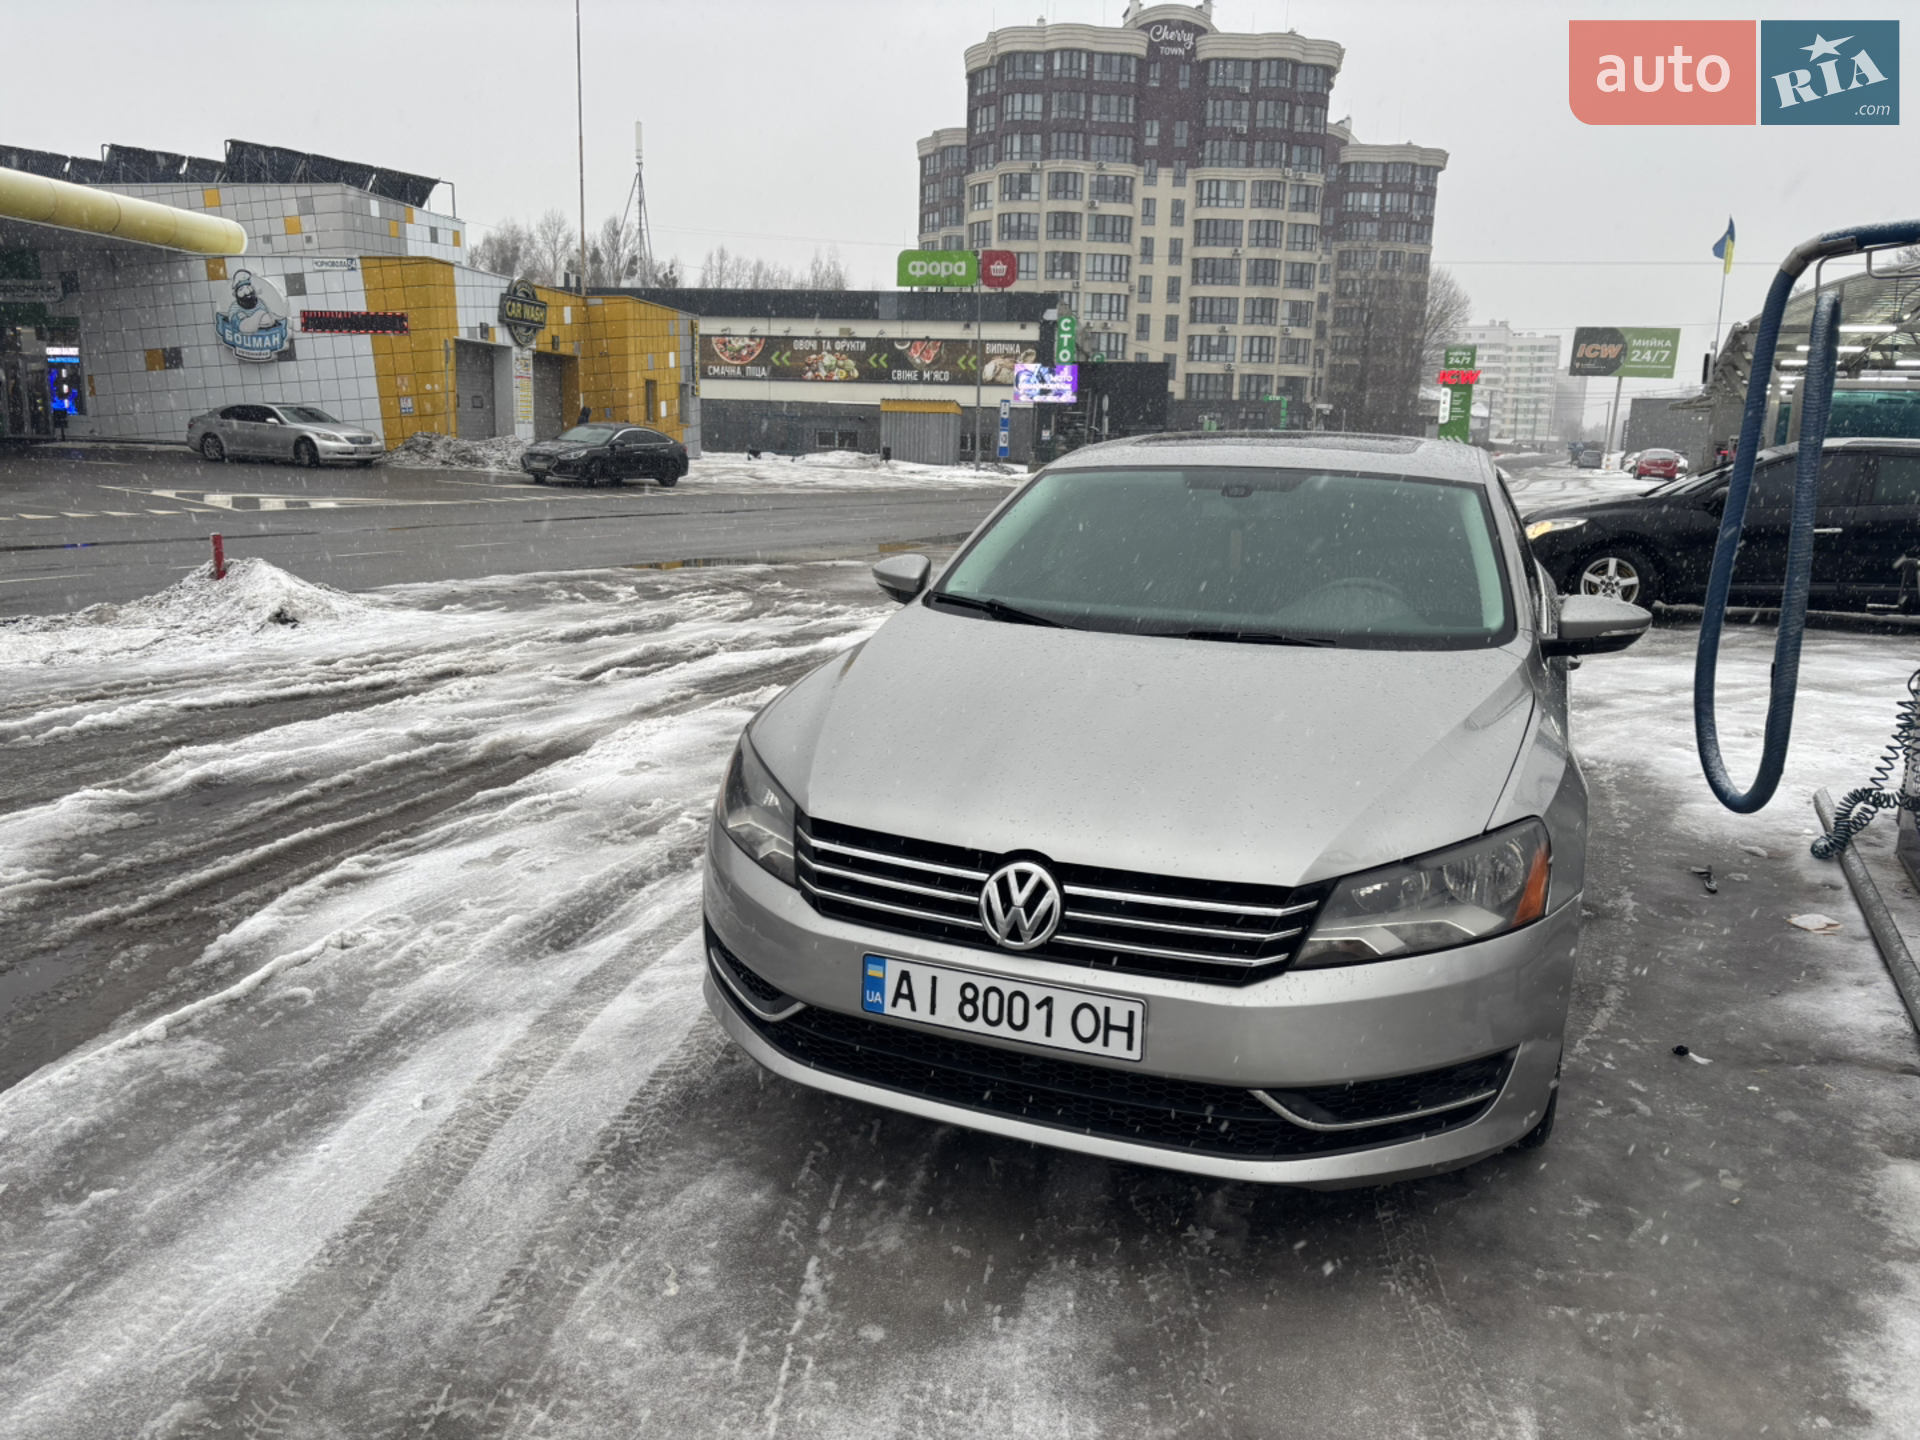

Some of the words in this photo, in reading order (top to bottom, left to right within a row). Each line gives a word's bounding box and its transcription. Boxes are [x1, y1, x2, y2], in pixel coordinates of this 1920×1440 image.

[1150, 24, 1194, 50] Cherry
[1159, 46, 1185, 56] TOWN
[908, 261, 966, 277] фора
[506, 300, 522, 318] CAR
[523, 303, 546, 324] WASH
[224, 329, 281, 349] БОЦМАН
[793, 340, 818, 351] ОВОЧІ
[822, 340, 831, 351] ТА
[834, 340, 866, 351] ФРУКТИ
[1060, 319, 1072, 362] СТО
[1631, 338, 1672, 347] МИЙКА
[985, 343, 1021, 354] ВИПІЧКА
[1576, 343, 1623, 358] ICW
[1448, 356, 1471, 365] 24/7
[1630, 349, 1671, 363] 24/7
[707, 365, 741, 376] СМАЧНА
[746, 366, 767, 377] ПІЦА
[891, 370, 919, 381] СВІЖЕ
[923, 370, 949, 382] М'ЯСО
[1437, 370, 1481, 384] ICW
[865, 990, 883, 1005] UA
[891, 970, 938, 1016] AI
[958, 981, 1054, 1038] 8001
[1070, 1002, 1135, 1051] OH
